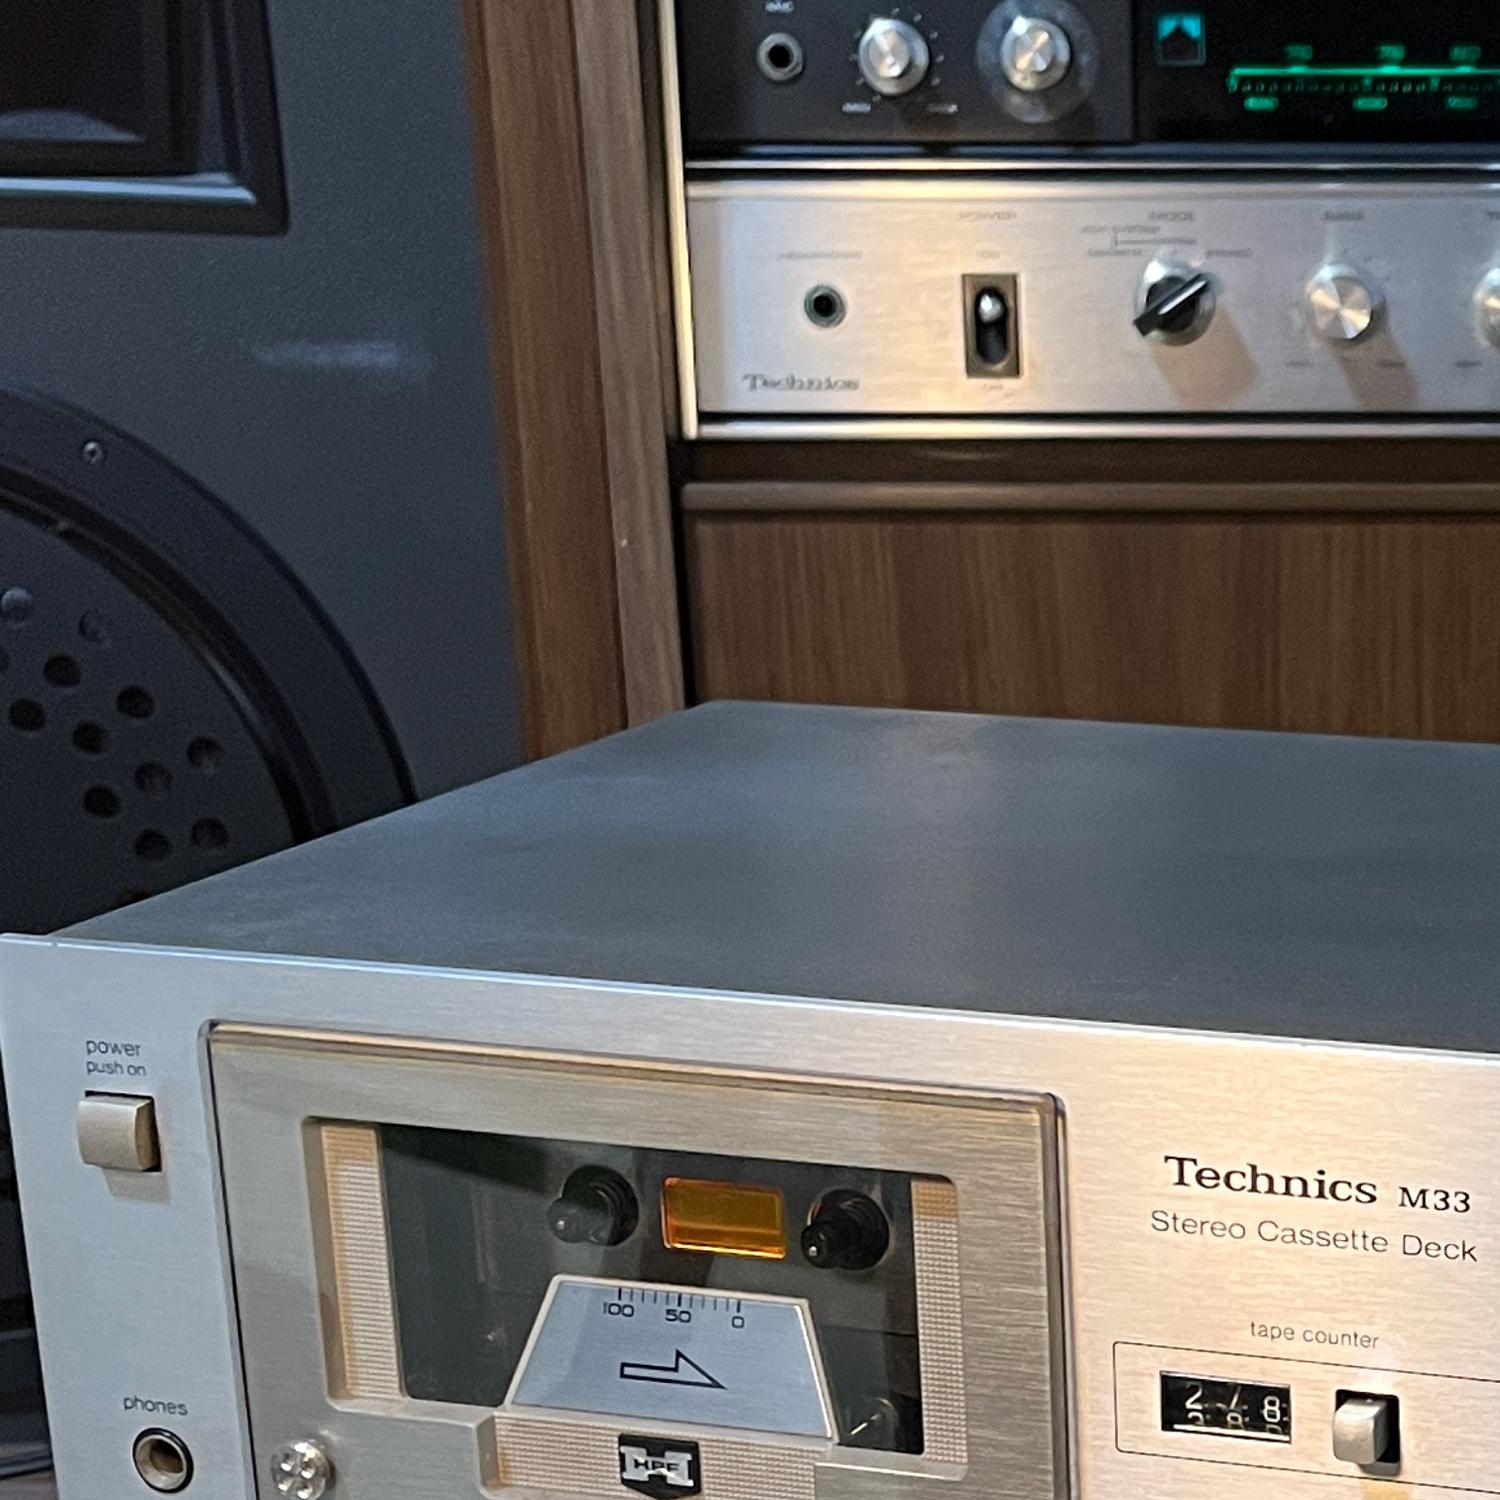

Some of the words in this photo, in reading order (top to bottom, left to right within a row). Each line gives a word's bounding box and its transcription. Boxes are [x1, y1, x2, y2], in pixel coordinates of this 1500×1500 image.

[742, 373, 860, 392] Technics
[86, 1040, 140, 1056] power
[87, 1061, 123, 1076] push
[127, 1065, 146, 1076] on
[1164, 1155, 1377, 1204] Technics
[1398, 1186, 1471, 1213] M33
[1151, 1209, 1246, 1240] Stereo
[1257, 1220, 1388, 1253] Cassette
[1402, 1234, 1478, 1262] Deck
[603, 1303, 634, 1317] 100
[665, 1309, 691, 1323] 50
[732, 1316, 745, 1328] 0
[1250, 1321, 1295, 1342] tape
[1302, 1328, 1379, 1349] counter
[123, 1396, 188, 1415] phones
